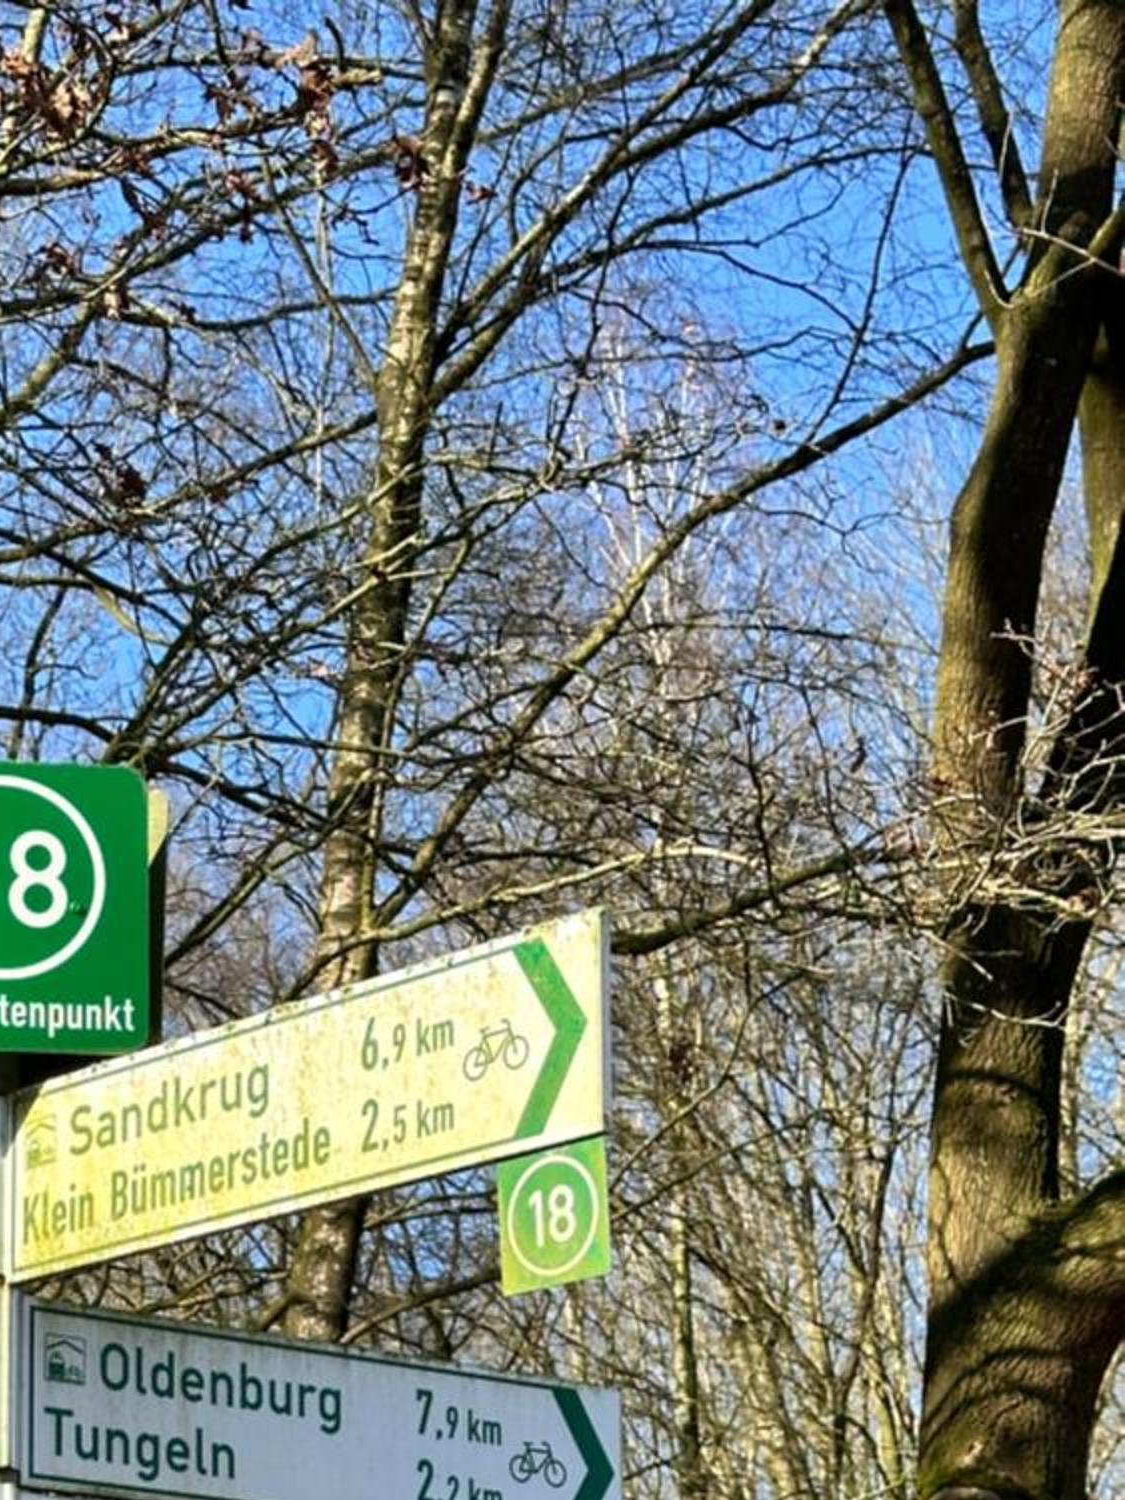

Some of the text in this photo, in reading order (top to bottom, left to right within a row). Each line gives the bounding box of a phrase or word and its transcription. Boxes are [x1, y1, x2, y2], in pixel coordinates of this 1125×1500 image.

[70, 1017, 454, 1155] Sandkrug 6,9 km
[24, 1099, 454, 1244] Klein Bümmerstede 2,5 km
[529, 1185, 575, 1246] 18
[44, 1407, 235, 1480] Tungeln
[101, 1344, 501, 1445] Oldenburg 7,9 km
